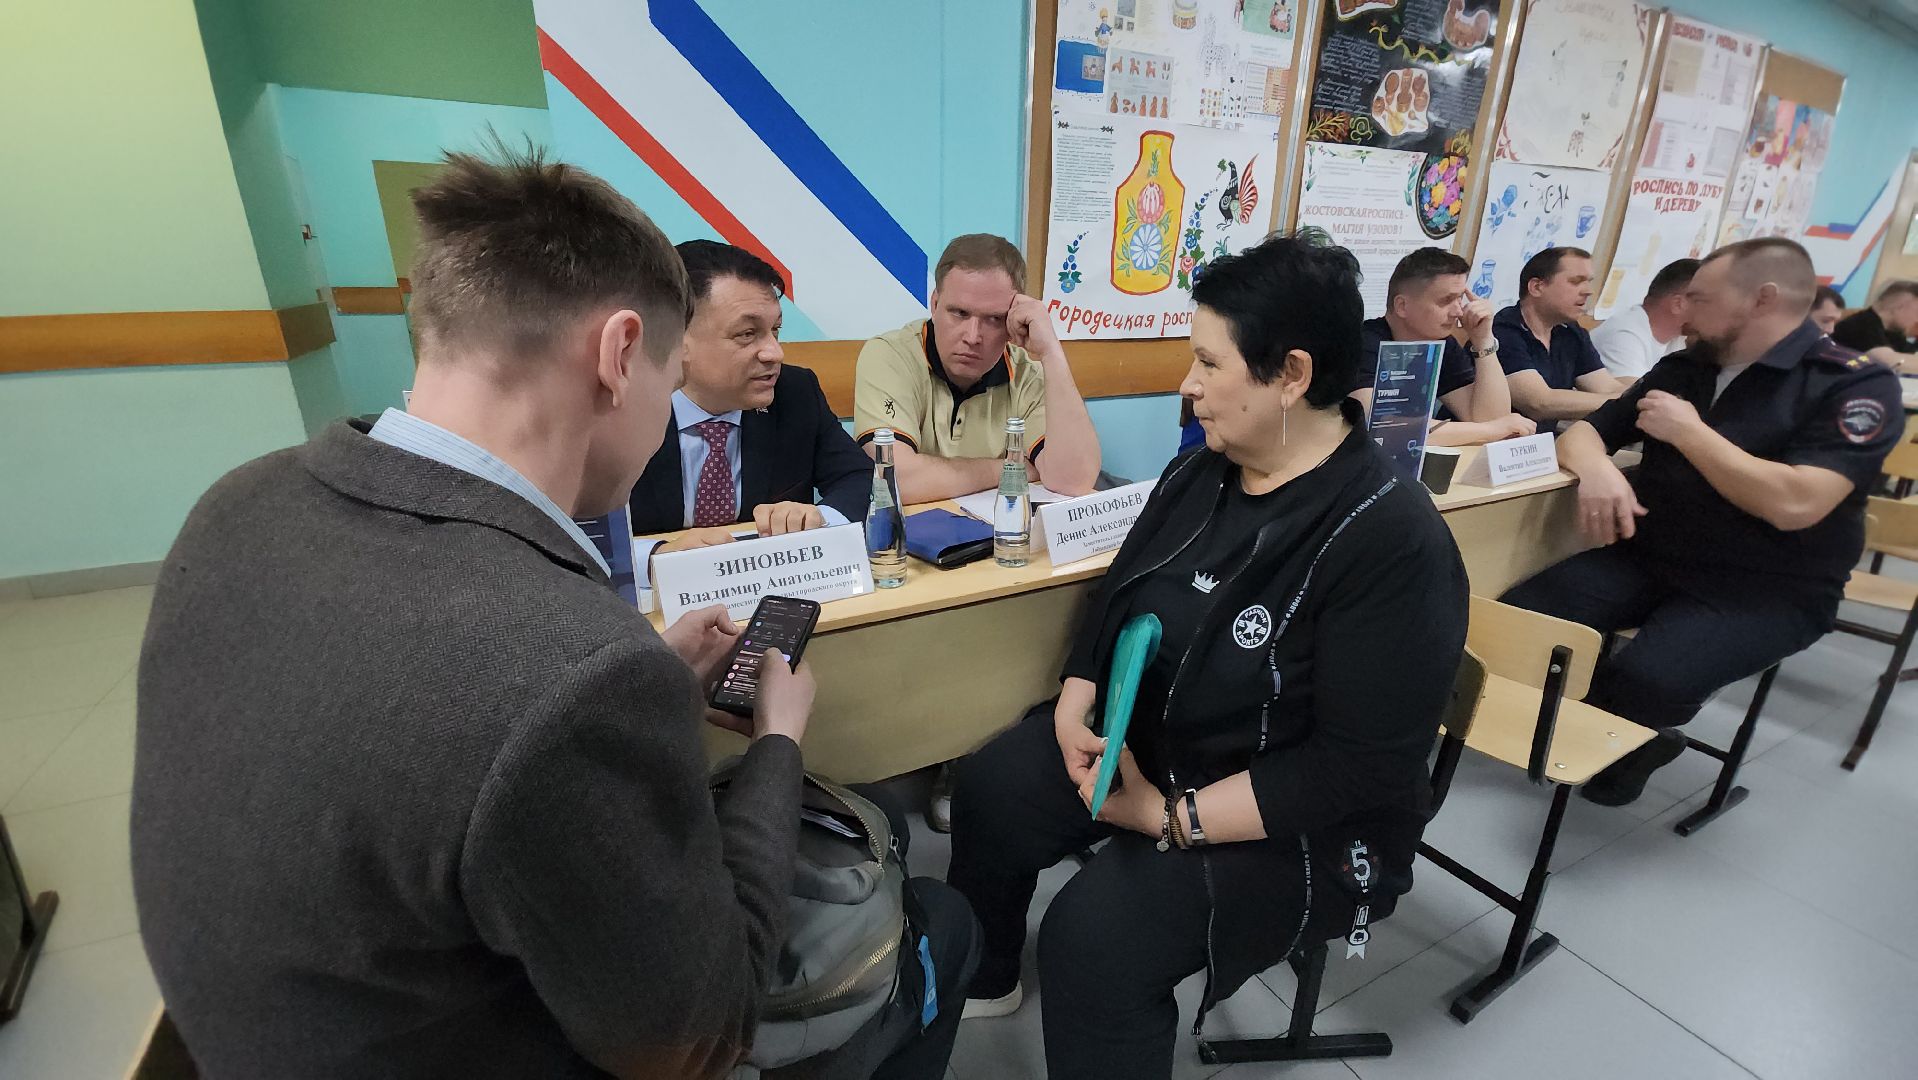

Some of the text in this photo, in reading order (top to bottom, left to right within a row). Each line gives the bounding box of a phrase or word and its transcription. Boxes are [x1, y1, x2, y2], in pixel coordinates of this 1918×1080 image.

[1633, 179, 1683, 196] РОСПИСЬ
[1685, 181, 1698, 196] ПО
[1332, 223, 1365, 235] МАГИЯ
[1048, 299, 1193, 336] Городецкая росп
[1510, 444, 1538, 458] ТУРКИН
[1067, 492, 1143, 522] ПРОКОФЬЕВ
[1056, 529, 1088, 547] Денис
[1090, 515, 1139, 536] Александр
[713, 545, 824, 577] ЗИНОВЬЕВ
[678, 563, 861, 607] Владимир Анатольевич
[1244, 608, 1267, 624] FASHION
[1237, 630, 1260, 646] SPORTS
[1351, 846, 1371, 881] 5
